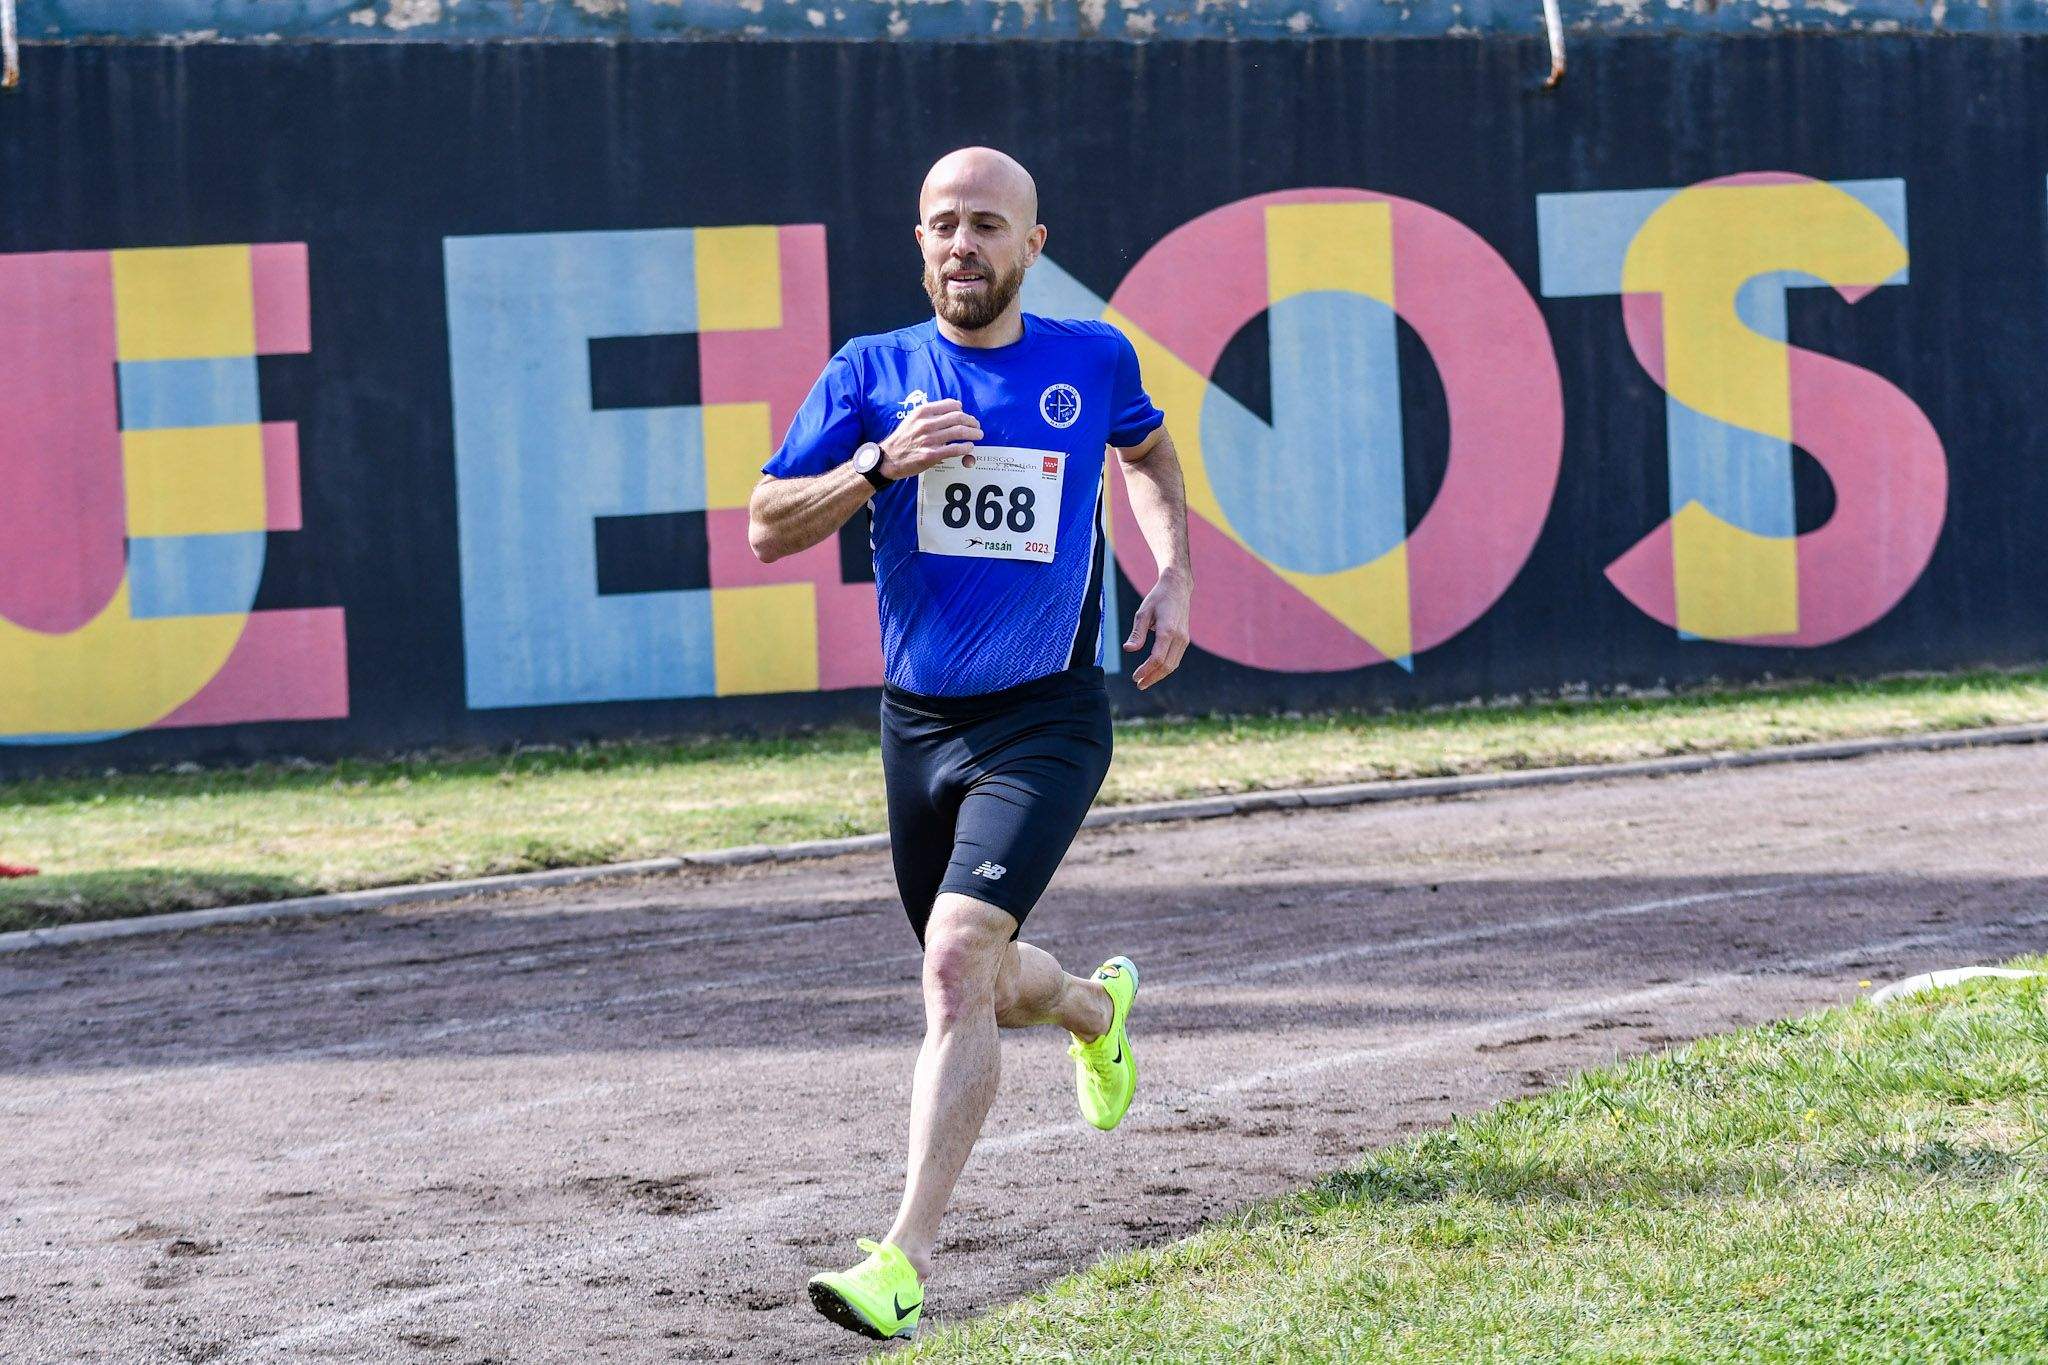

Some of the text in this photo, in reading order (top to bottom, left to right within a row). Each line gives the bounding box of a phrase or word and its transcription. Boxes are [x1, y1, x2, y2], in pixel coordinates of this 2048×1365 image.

[976, 455, 1015, 463] RIESGO
[942, 482, 1036, 533] 868
[984, 540, 1049, 554] rasán 2023
